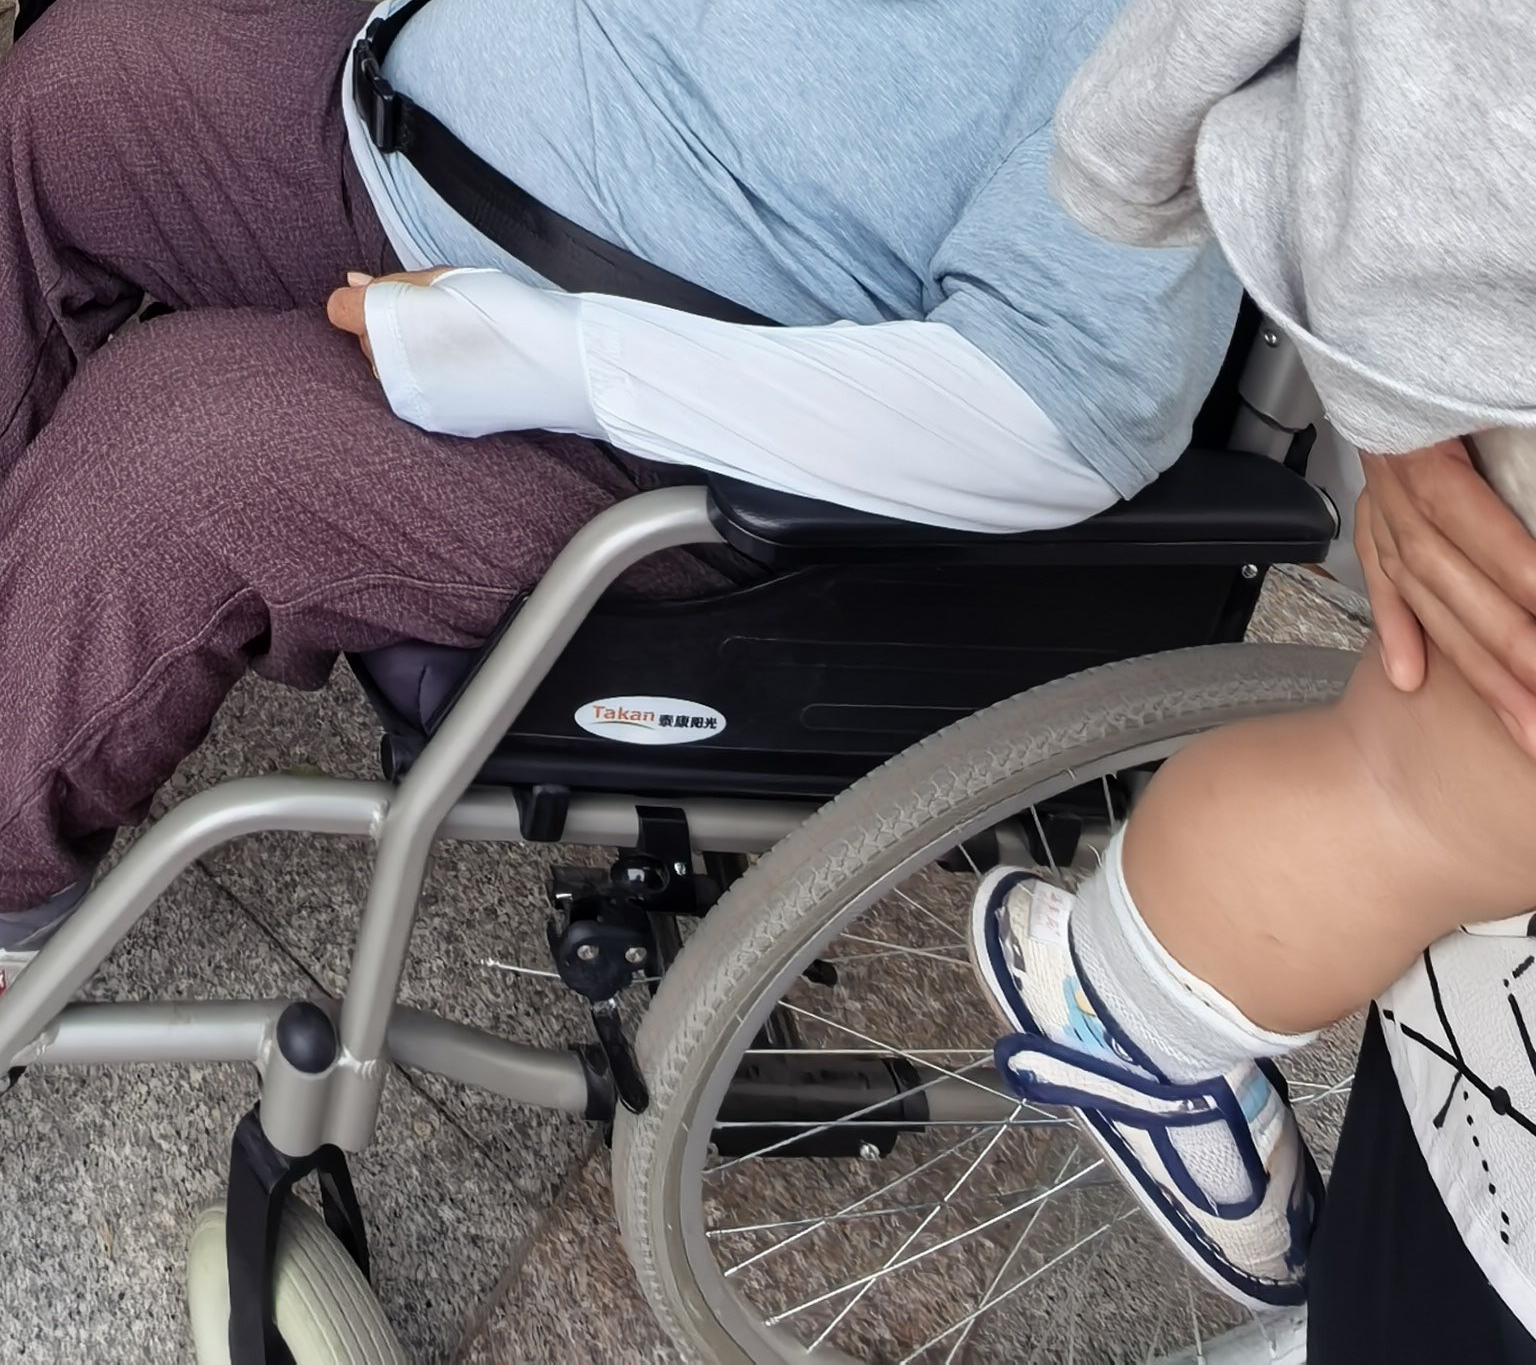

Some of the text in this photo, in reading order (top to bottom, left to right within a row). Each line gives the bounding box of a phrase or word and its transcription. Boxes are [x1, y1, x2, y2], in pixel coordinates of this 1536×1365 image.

[592, 705, 718, 730] Takan 泰康阳光
